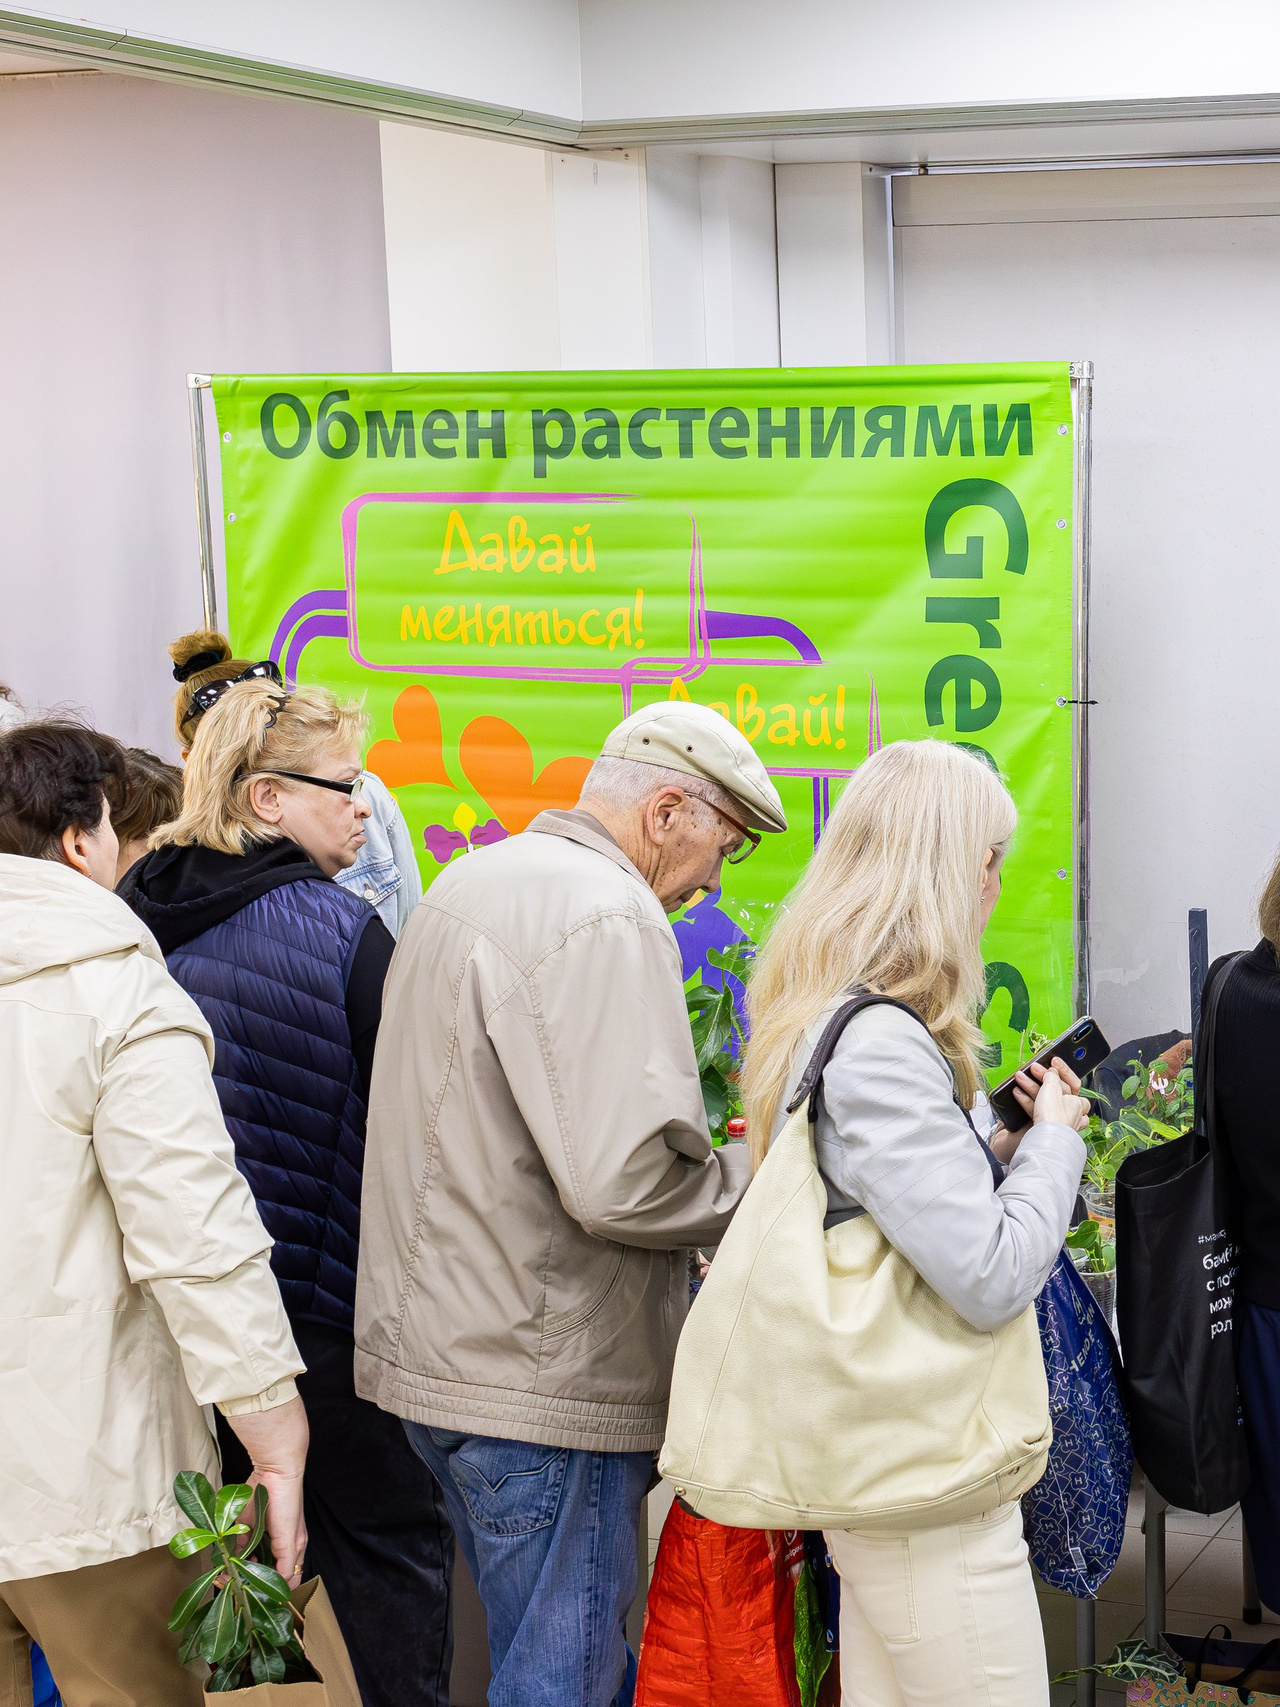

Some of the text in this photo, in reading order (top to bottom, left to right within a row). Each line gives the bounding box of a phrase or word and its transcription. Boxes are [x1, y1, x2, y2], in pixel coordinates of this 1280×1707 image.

[260, 391, 1034, 479] Обмен растениями
[434, 509, 597, 575] Давай
[400, 588, 645, 651] меняться!
